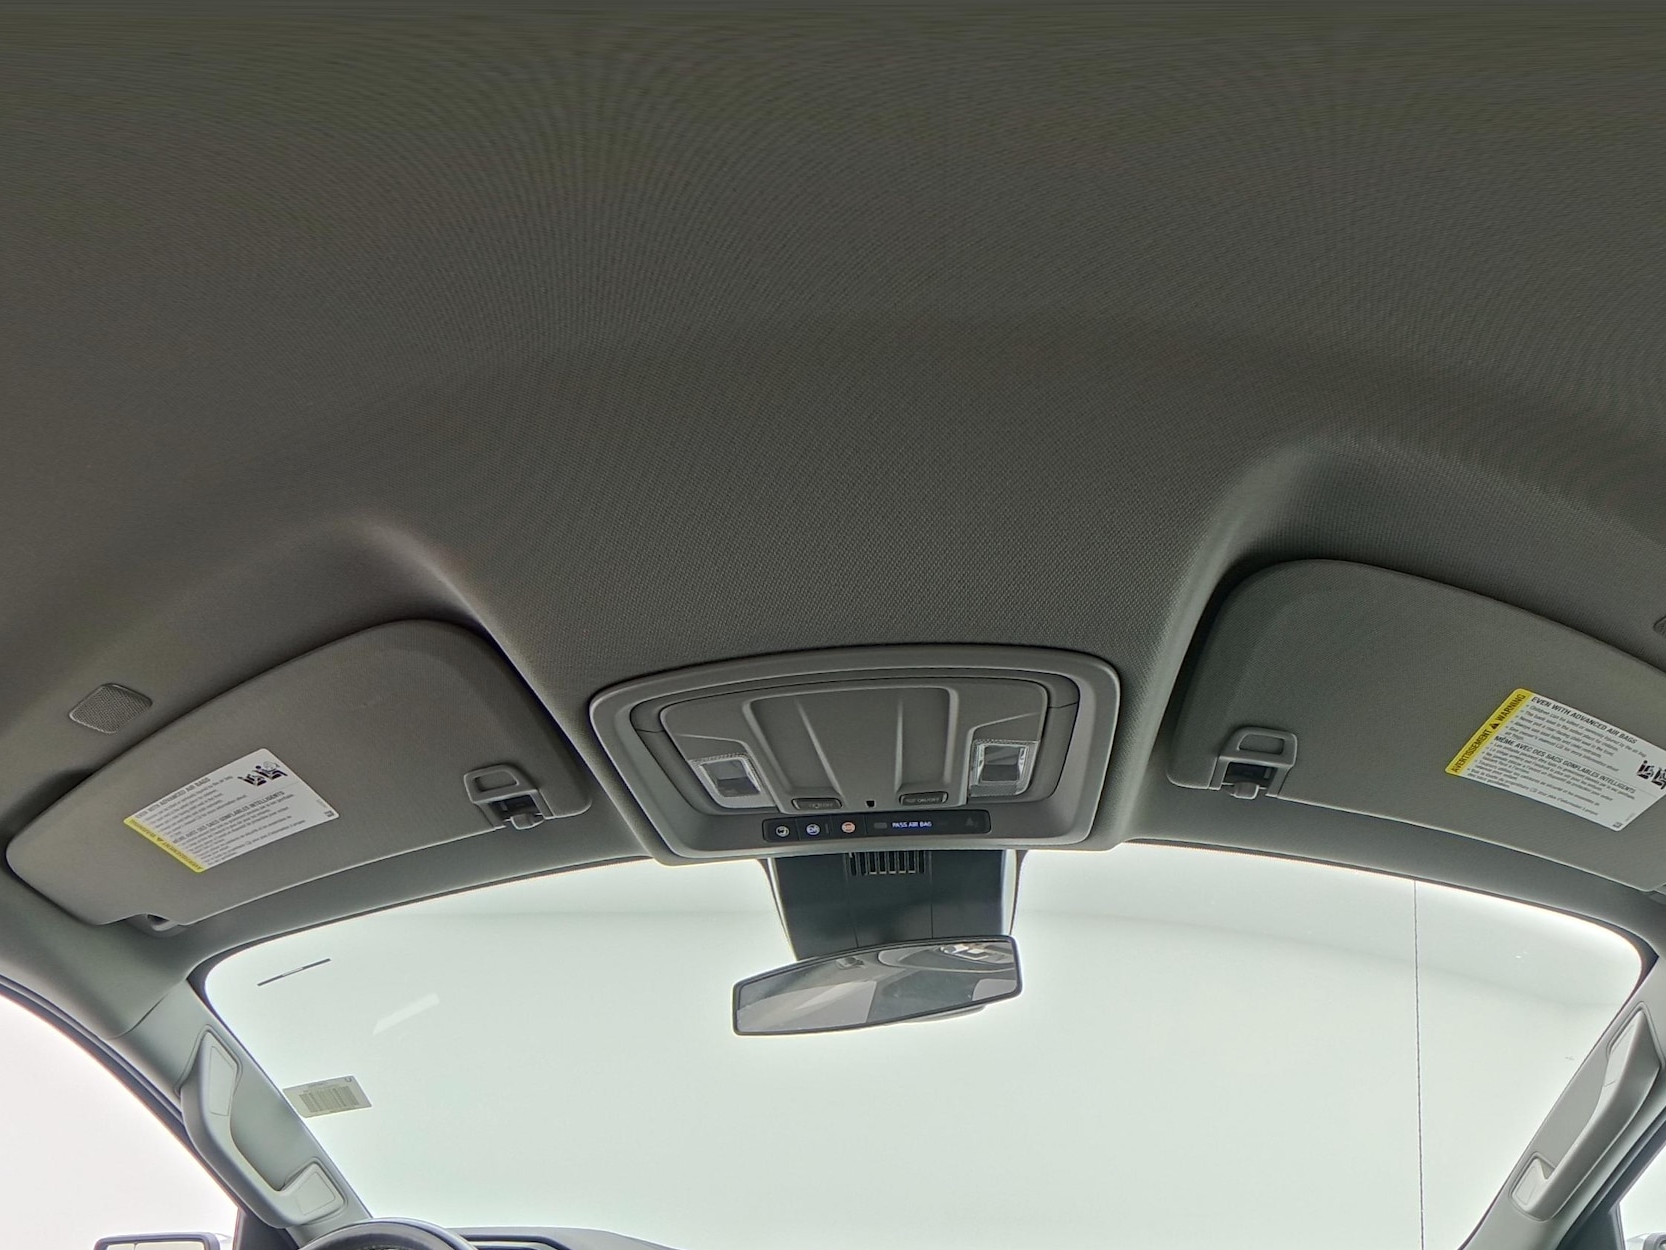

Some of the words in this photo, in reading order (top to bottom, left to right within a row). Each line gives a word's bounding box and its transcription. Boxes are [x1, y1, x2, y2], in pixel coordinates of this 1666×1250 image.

[1495, 692, 1526, 722] WARNING
[1530, 695, 1552, 708] EVEN
[1550, 703, 1571, 715] WITH
[1569, 711, 1608, 731] ADVANCED
[1605, 727, 1620, 736] AIR
[1617, 732, 1638, 744] BAGS
[1449, 728, 1493, 772] AVERTISSEMENT
[1514, 741, 1533, 752] AVEC
[1530, 748, 1547, 757] DES
[1544, 752, 1564, 763] SACS
[1560, 759, 1601, 778] GONFLABLES
